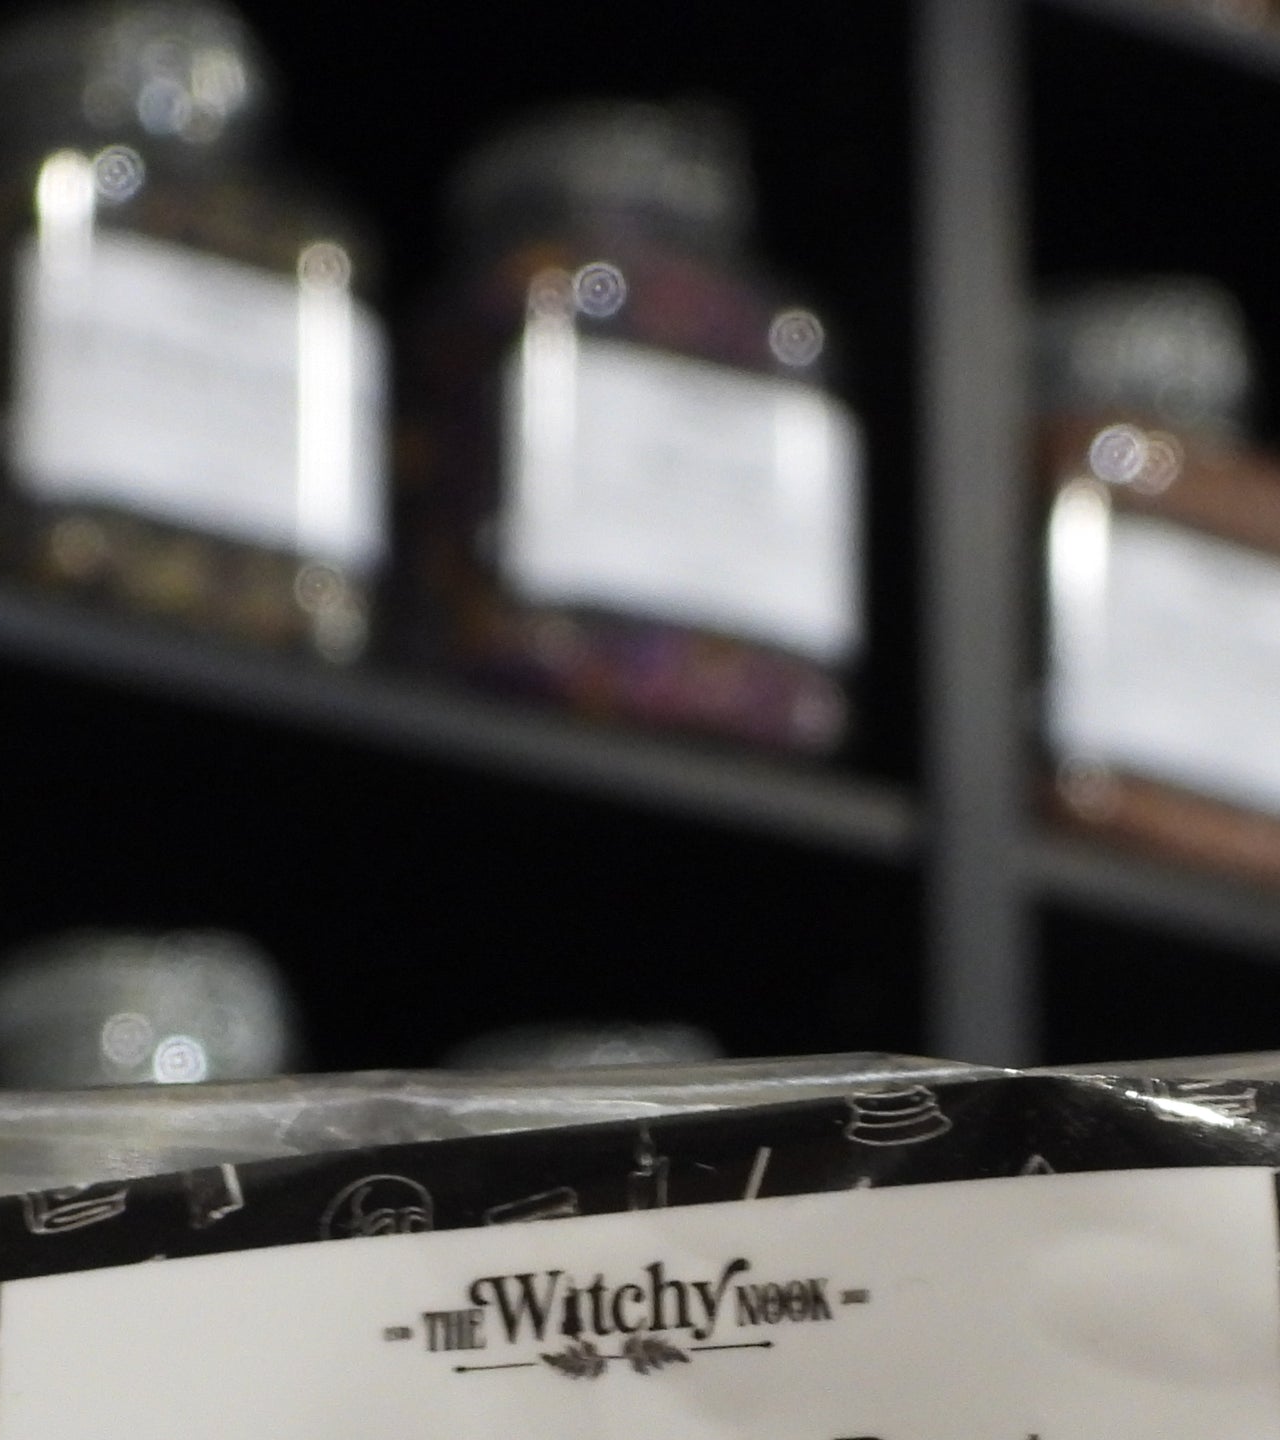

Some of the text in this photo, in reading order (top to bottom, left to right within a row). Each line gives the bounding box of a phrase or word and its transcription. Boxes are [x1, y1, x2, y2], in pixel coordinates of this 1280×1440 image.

[421, 1257, 834, 1353] THE Witchy NOOK
